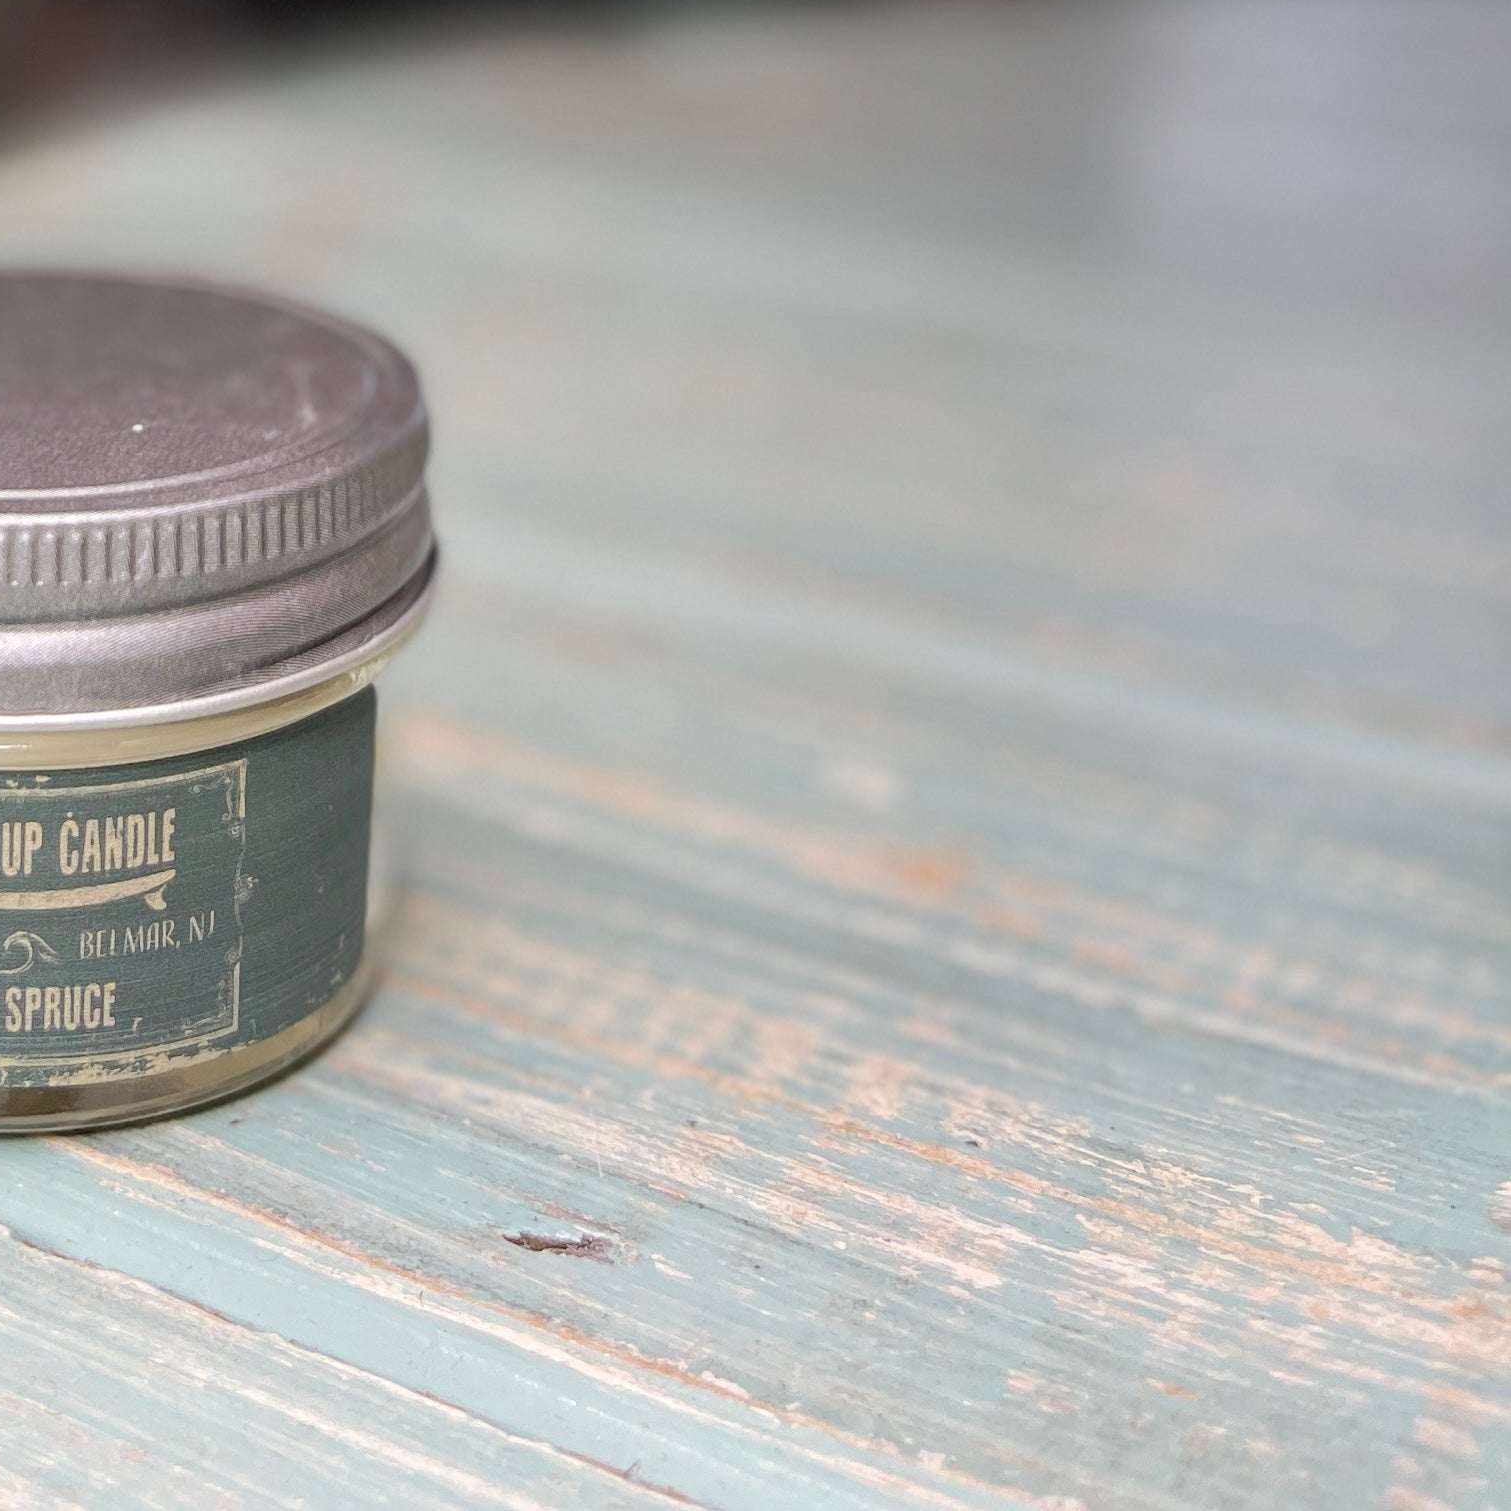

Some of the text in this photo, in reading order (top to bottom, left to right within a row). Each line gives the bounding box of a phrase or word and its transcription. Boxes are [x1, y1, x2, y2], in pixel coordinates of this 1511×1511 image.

[1, 819, 43, 876] UP
[59, 807, 177, 876] CANDLE
[80, 910, 215, 960] BELMAR, NJ
[5, 981, 117, 1033] SPRUCE
